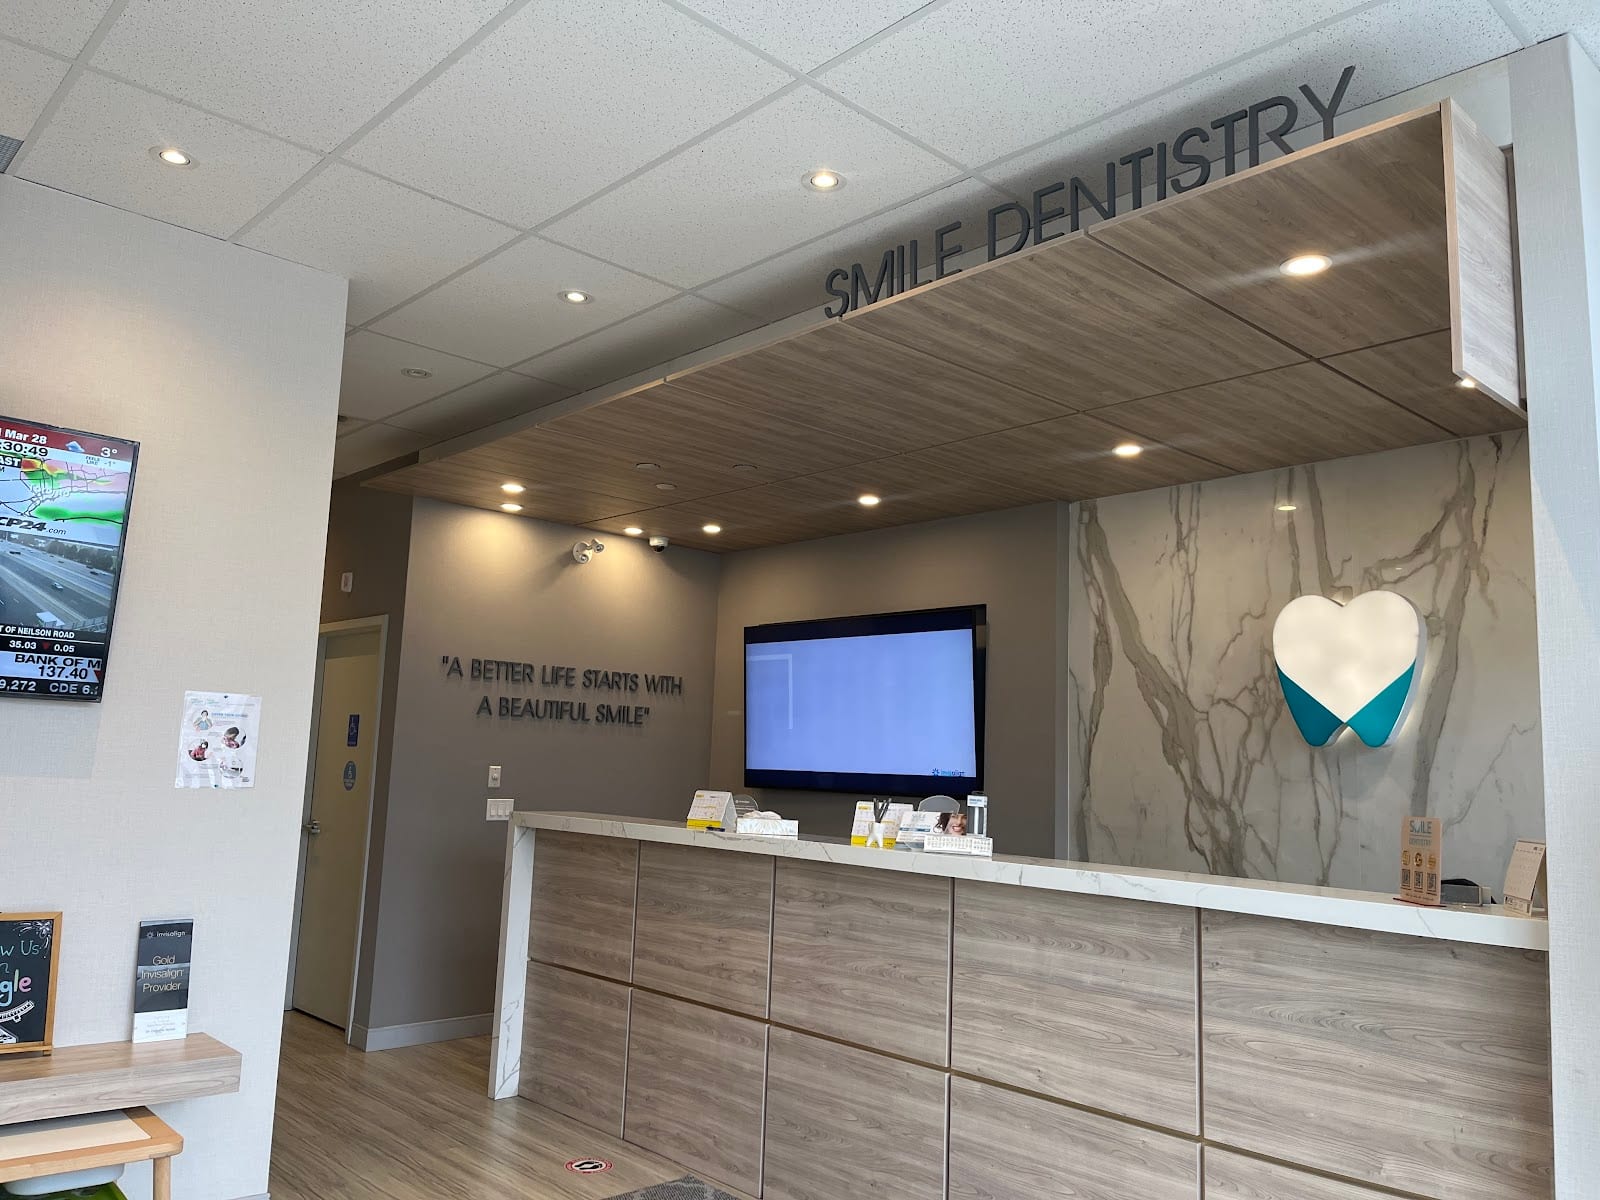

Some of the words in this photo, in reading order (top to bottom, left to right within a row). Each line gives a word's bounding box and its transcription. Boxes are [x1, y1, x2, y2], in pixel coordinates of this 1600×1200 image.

[823, 220, 963, 319] SMILE
[987, 65, 1356, 262] DENTISTRY
[4, 428, 29, 441] Mar
[31, 433, 48, 445] 28
[5, 626, 16, 634] OF
[17, 627, 52, 637] NEILSON
[52, 630, 75, 639] ROAD
[9, 640, 37, 649] 35.03
[54, 643, 75, 652] 0.05
[15, 653, 58, 666] BANK
[63, 657, 84, 667] OF
[38, 664, 88, 680] 137.40
[442, 655, 463, 678] "A
[470, 658, 535, 683] BETTER
[541, 664, 576, 688] LIFE
[582, 668, 639, 693] STARTS
[644, 673, 682, 695] WITH
[49, 682, 78, 694] CDE
[476, 695, 492, 717] A
[498, 696, 590, 722] BEAUTIFUL
[595, 703, 650, 726] SMILE"
[20, 940, 40, 956] Us
[152, 954, 176, 966] Gold
[142, 981, 182, 993] Provider
